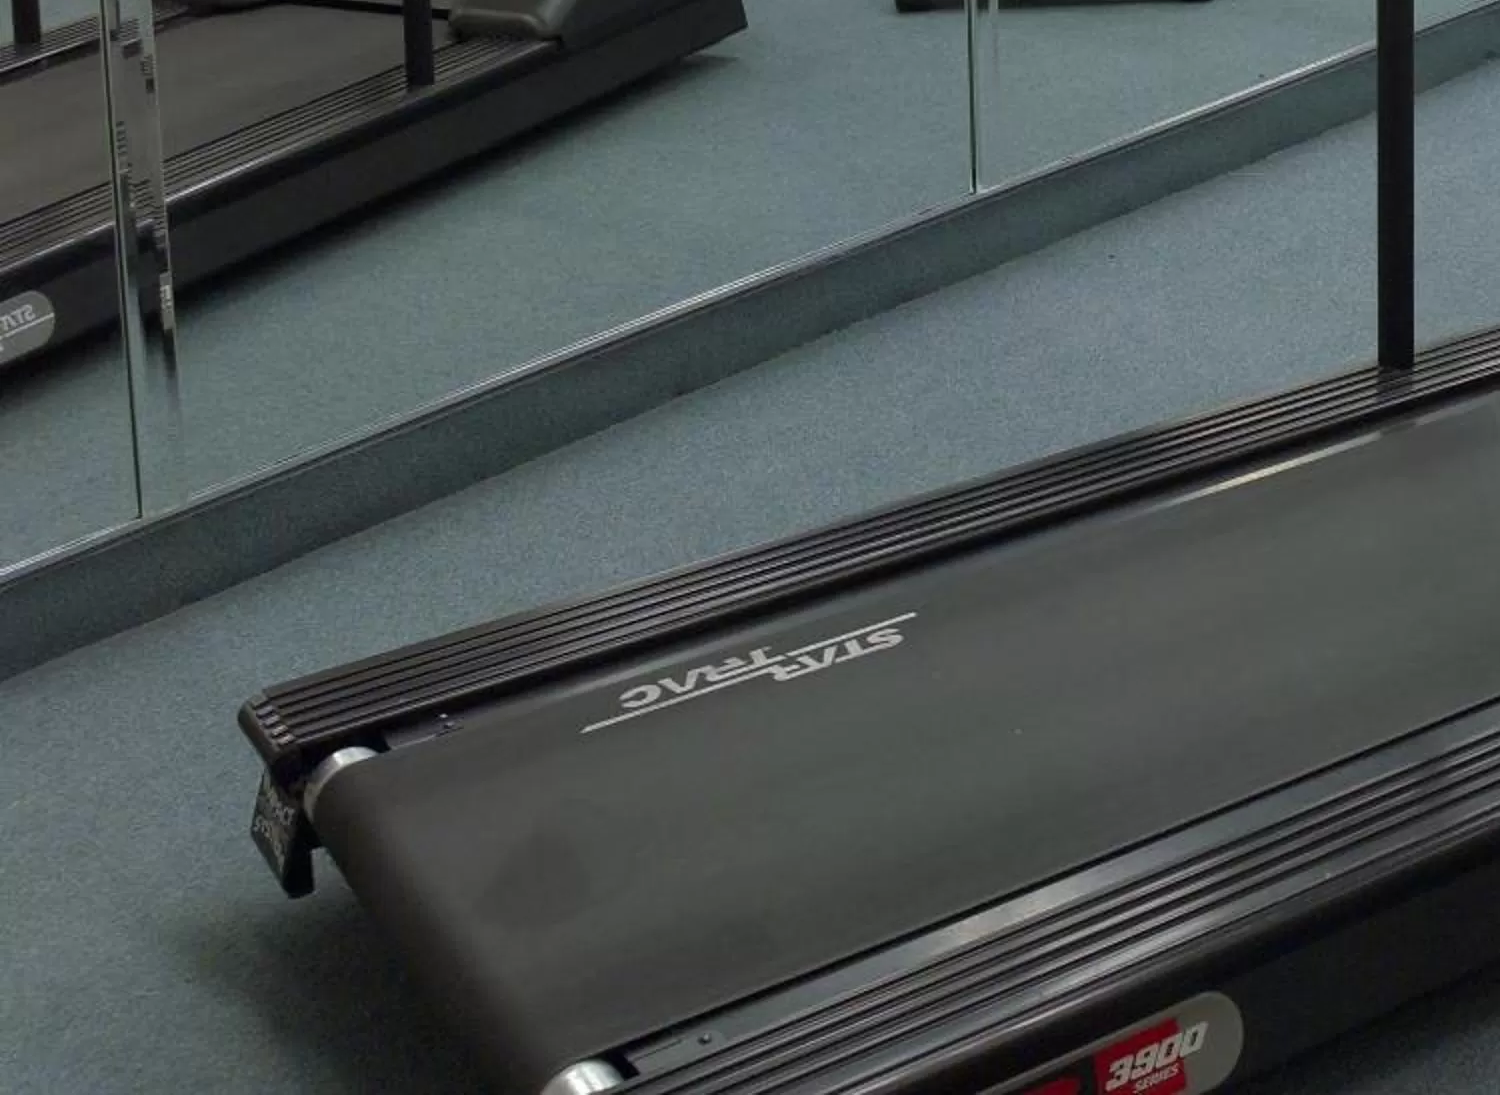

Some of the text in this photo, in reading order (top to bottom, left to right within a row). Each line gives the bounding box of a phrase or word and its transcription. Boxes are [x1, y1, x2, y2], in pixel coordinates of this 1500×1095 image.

[619, 647, 788, 708] TRAC
[767, 628, 904, 682] STAR
[1104, 1021, 1209, 1093] 3900
